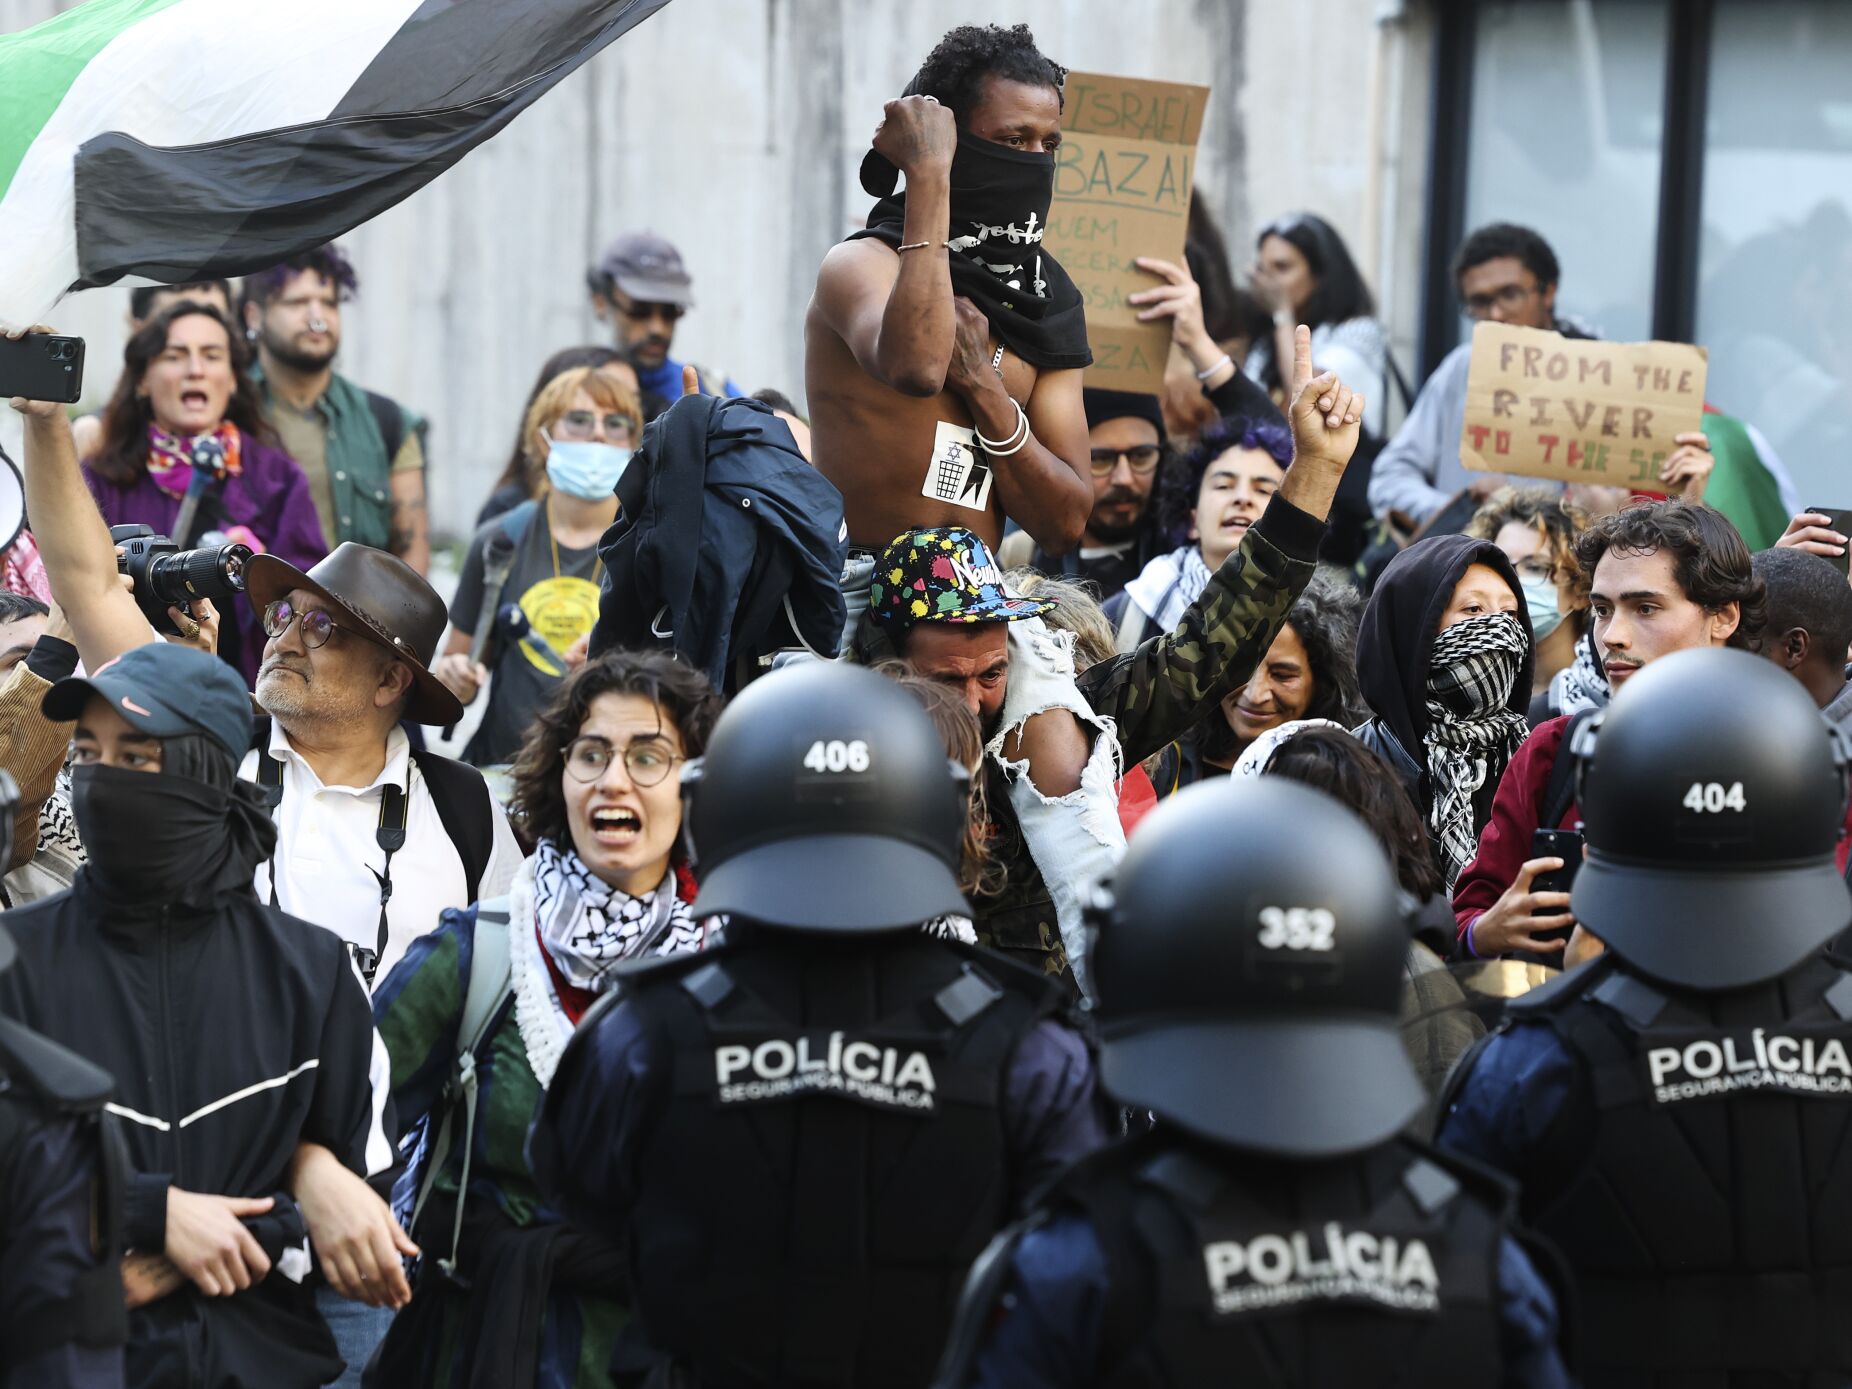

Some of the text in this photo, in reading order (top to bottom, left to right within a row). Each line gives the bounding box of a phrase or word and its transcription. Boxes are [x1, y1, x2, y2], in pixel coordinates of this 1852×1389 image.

[1055, 142, 1188, 206] BAZA!
[1046, 215, 1120, 246] UEM
[1093, 344, 1151, 375] ZA
[1500, 342, 1693, 394] FROM THE
[1493, 388, 1656, 439] RIVER
[1468, 425, 1670, 482] TO THE SE
[803, 740, 870, 773] 406
[1682, 781, 1747, 814] 404
[1257, 906, 1337, 952] 352
[715, 1030, 936, 1093] POLÍCIA
[1648, 1027, 1852, 1087] POLÍCIA
[1203, 1220, 1440, 1296] POLÍCIA
